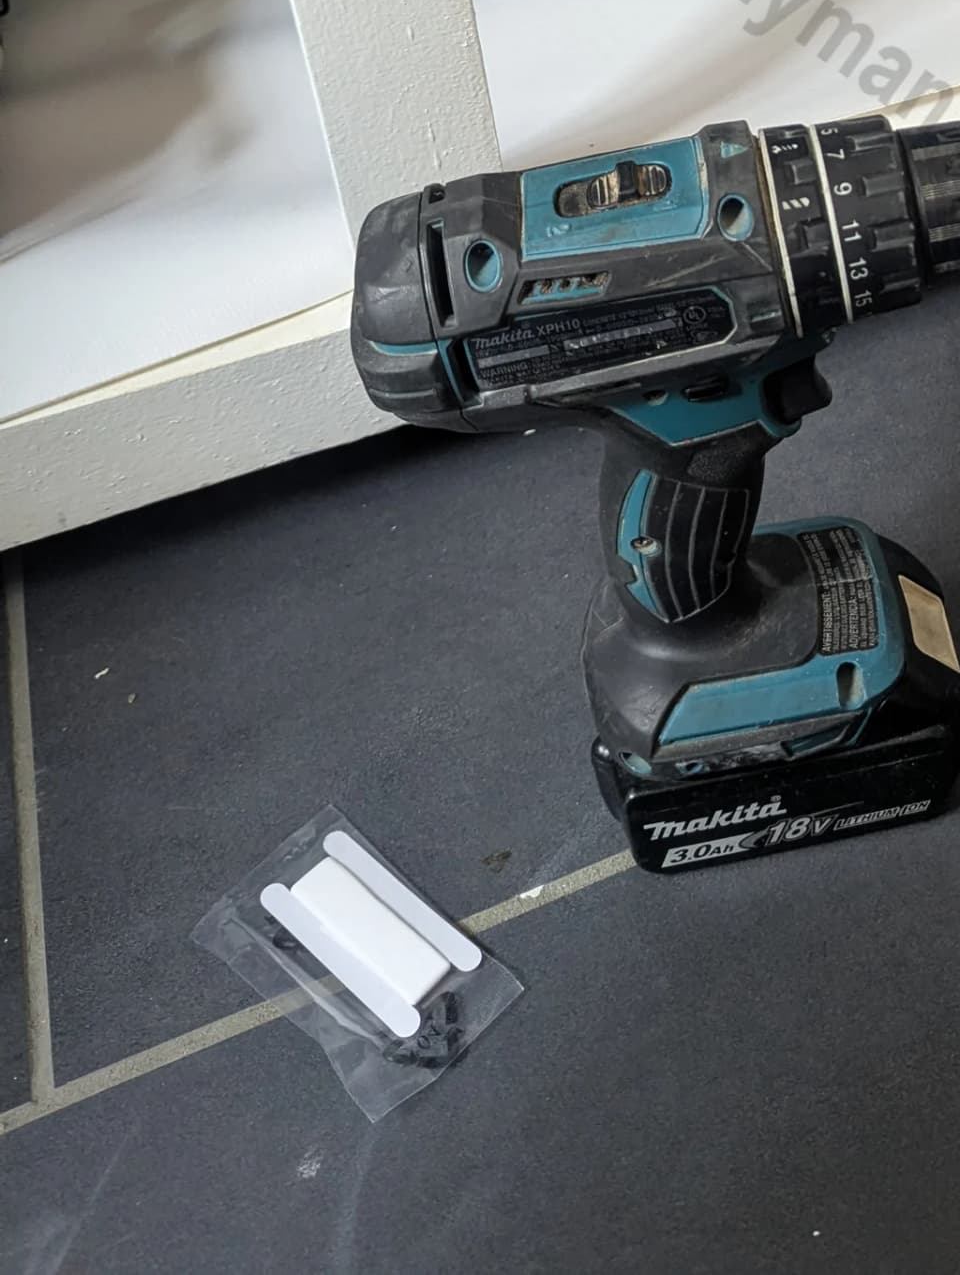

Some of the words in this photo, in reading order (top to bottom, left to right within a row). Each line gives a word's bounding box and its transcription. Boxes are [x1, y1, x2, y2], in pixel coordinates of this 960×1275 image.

[825, 148, 846, 160] 7
[833, 181, 853, 196] 9
[841, 219, 863, 243] 11
[848, 257, 870, 281] 13
[854, 289, 873, 309] 15
[536, 317, 580, 337] XPH10
[670, 842, 735, 864] 3.0Ah
